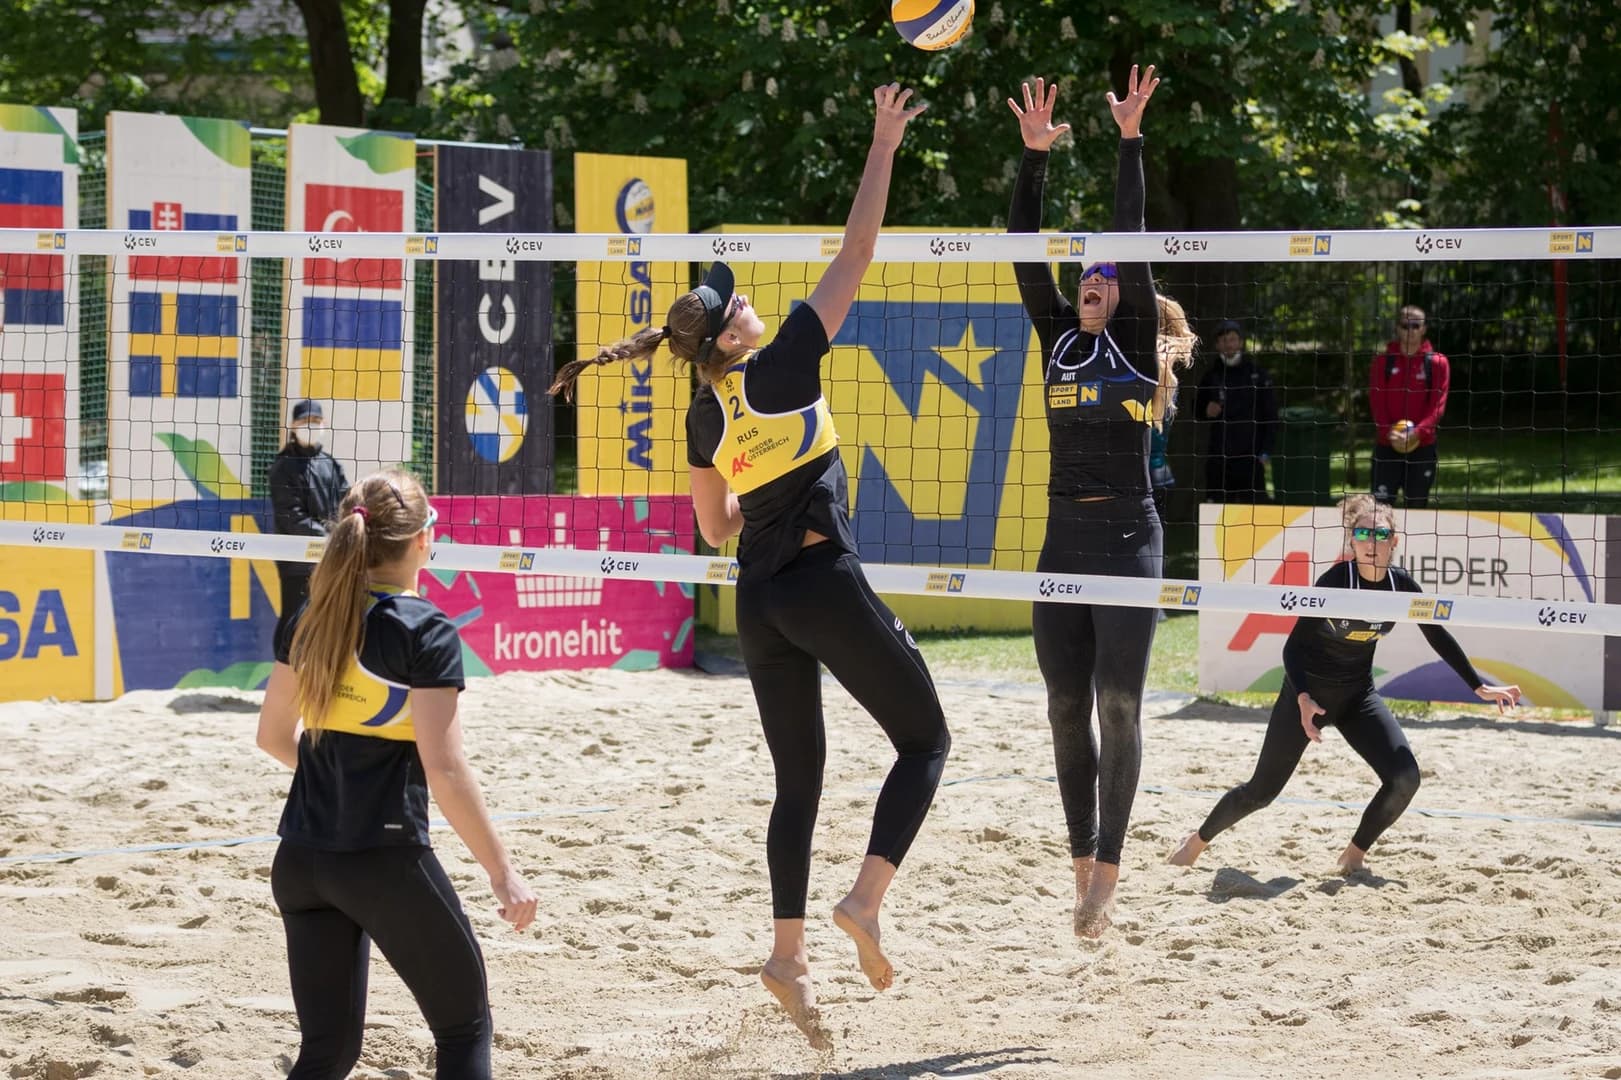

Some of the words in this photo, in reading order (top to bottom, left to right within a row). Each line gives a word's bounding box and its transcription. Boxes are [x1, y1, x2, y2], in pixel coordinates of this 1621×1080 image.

[138, 237, 157, 247] CEV
[323, 239, 343, 249] CEV
[522, 241, 543, 251] CEV
[729, 242, 751, 252] CEV
[947, 241, 971, 252] CEV
[1183, 240, 1208, 251] CEV
[1436, 238, 1462, 249] CEV
[1105, 348, 1116, 369] 1
[1061, 372, 1076, 381] AUT
[728, 395, 745, 421] 2
[736, 427, 759, 445] RUS
[748, 438, 773, 454] NIEDER
[731, 452, 753, 478] AK
[46, 530, 65, 541] CEV
[225, 540, 245, 551] CEV
[616, 560, 639, 572] CEV
[1057, 583, 1082, 595] CEV
[1299, 596, 1326, 608] CEV
[1558, 611, 1587, 624] CEV
[494, 617, 623, 661] kronehit
